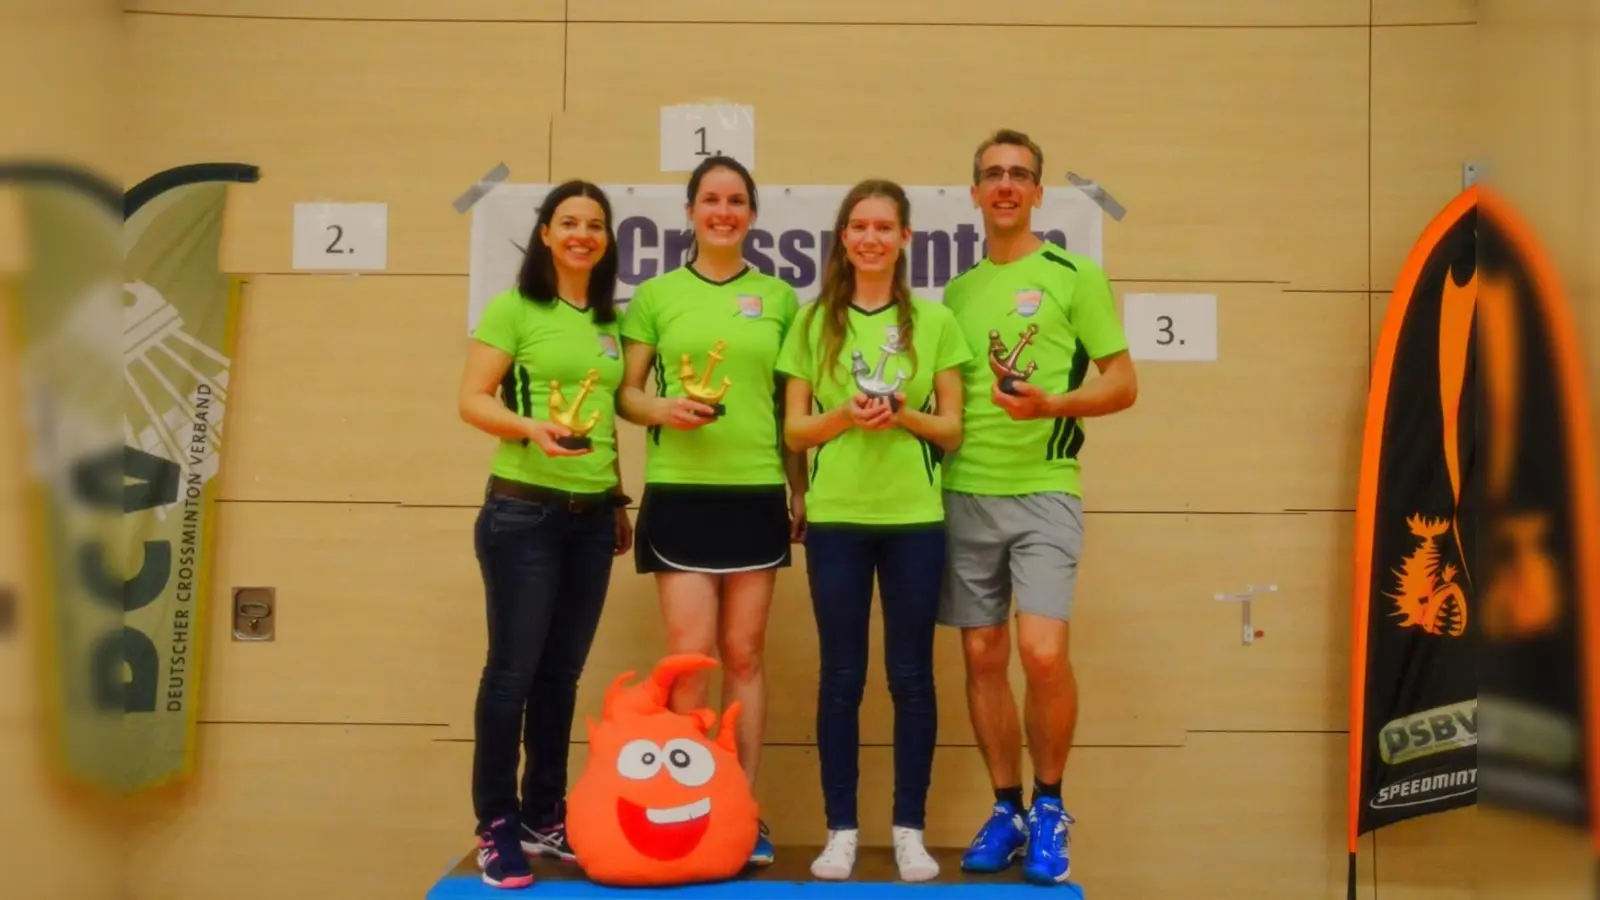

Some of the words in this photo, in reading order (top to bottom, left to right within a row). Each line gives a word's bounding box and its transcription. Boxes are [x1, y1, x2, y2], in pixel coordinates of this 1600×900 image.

[694, 126, 722, 157] 1.
[325, 225, 355, 255] 2.
[617, 215, 1067, 289] Crssnt
[1155, 315, 1186, 346] 3.
[189, 383, 212, 466] VERBAND
[176, 473, 202, 602] CROSSMINTON
[167, 609, 189, 712] DEUTSCHER
